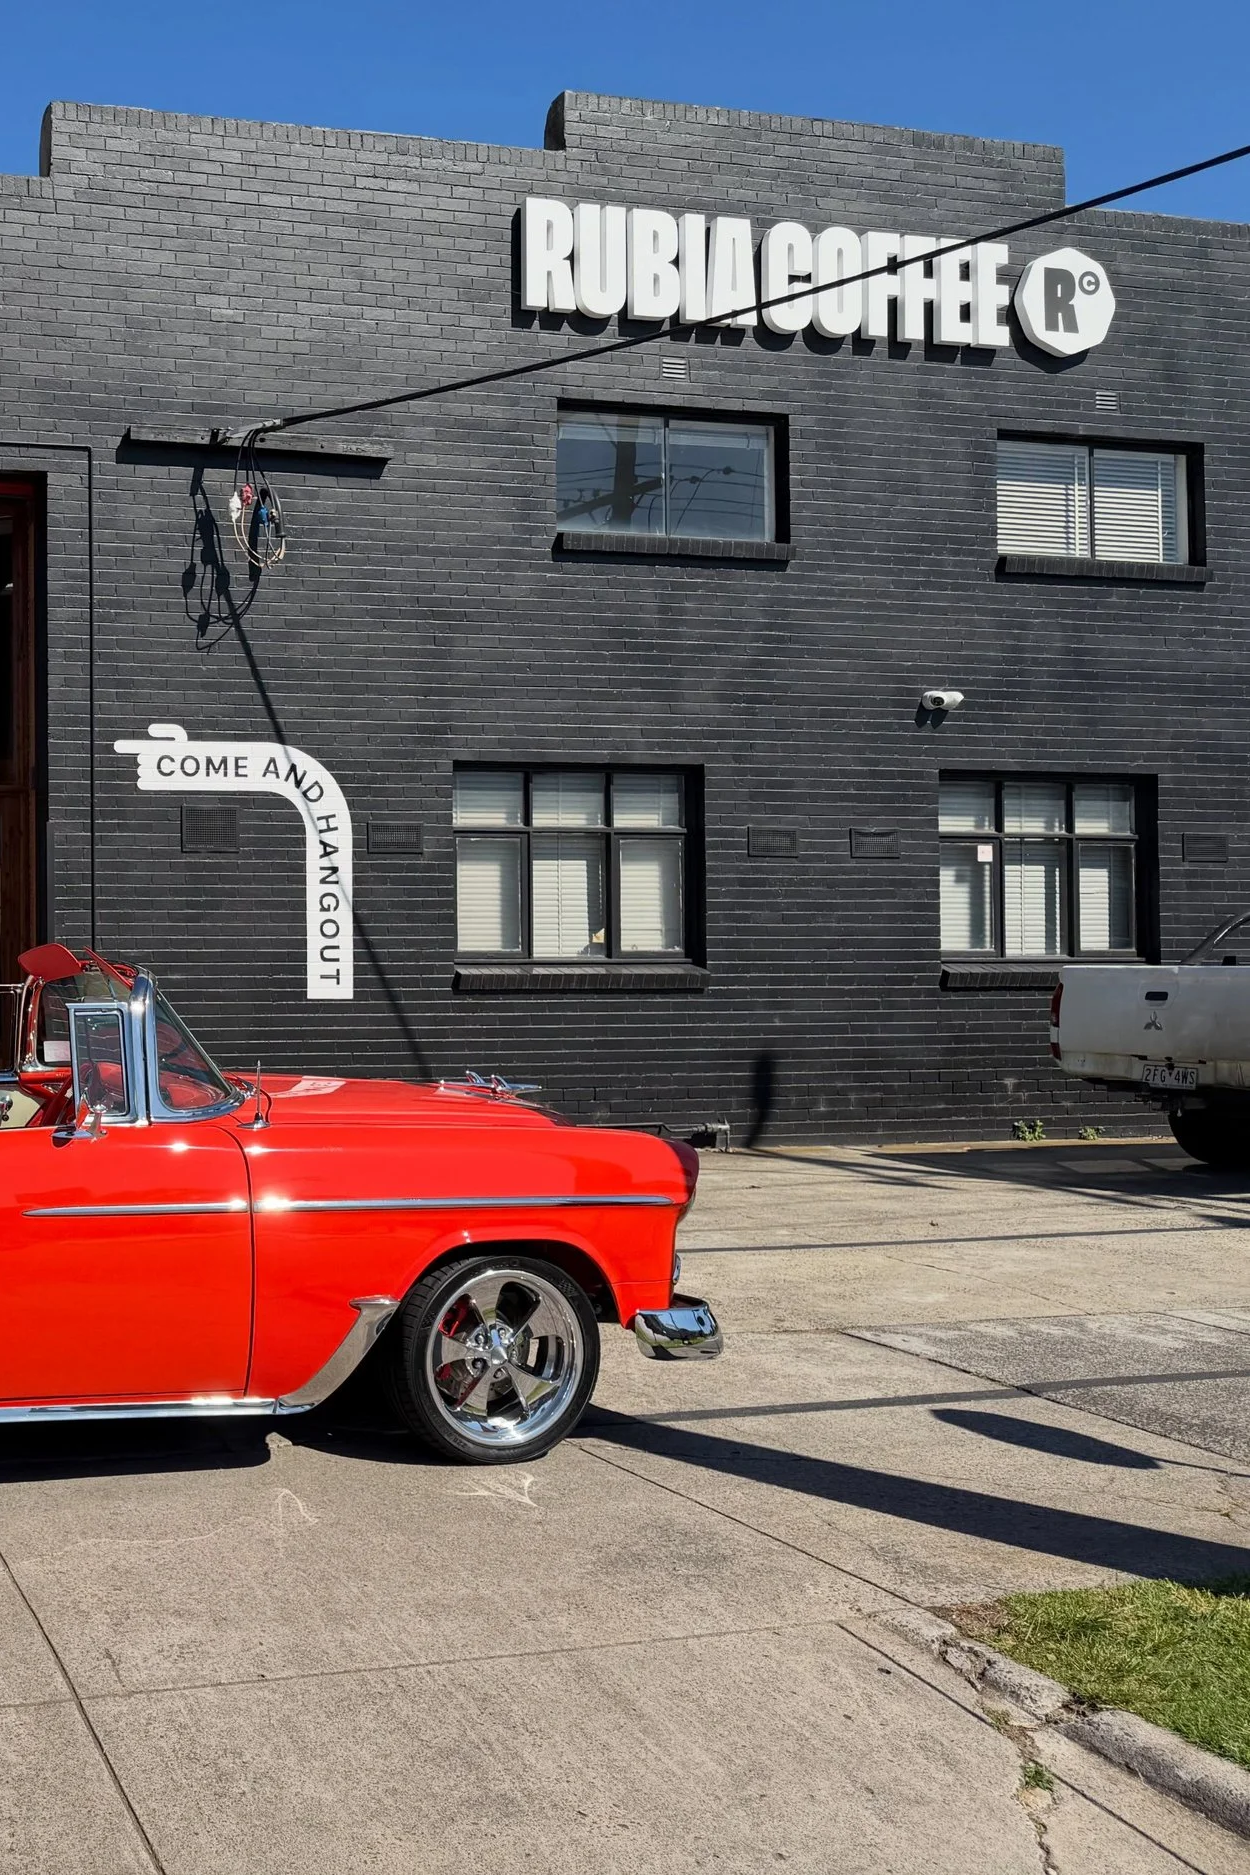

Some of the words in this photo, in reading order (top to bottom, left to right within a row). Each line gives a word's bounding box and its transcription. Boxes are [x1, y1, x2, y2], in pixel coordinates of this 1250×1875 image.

[521, 197, 758, 326] RUBIA
[762, 222, 1009, 348] COFFEE
[156, 755, 248, 778] COME
[262, 756, 324, 803] AND
[316, 813, 340, 986] HANGOUT
